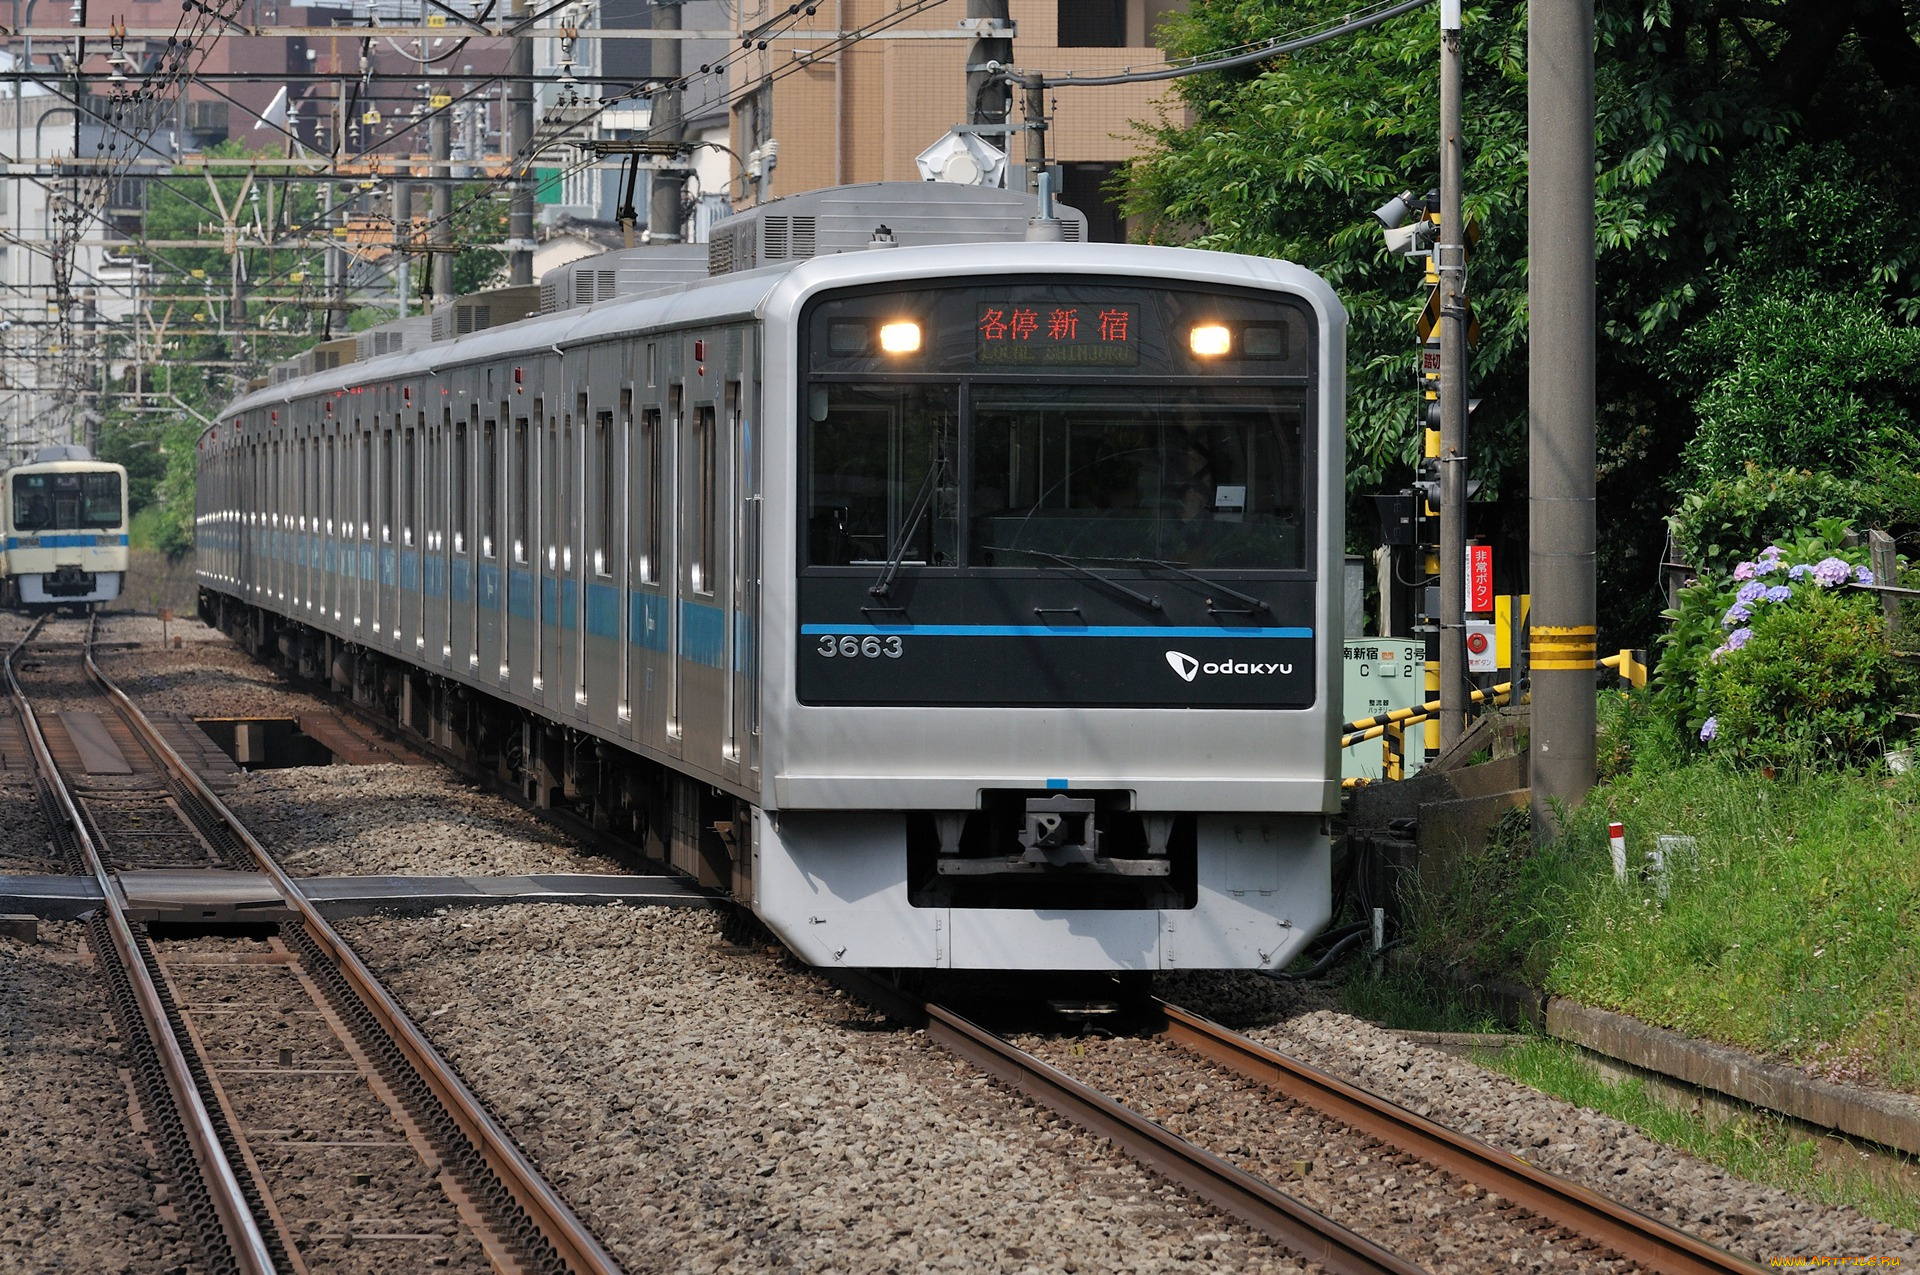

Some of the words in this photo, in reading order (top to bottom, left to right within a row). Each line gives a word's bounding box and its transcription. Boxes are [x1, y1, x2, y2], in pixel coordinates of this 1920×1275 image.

[980, 308, 1039, 341] 各停
[1475, 550, 1488, 608] 非常ボタン
[817, 634, 904, 659] 3663
[1344, 647, 1379, 660] 南新宿
[1203, 659, 1293, 674] odakyu
[1360, 664, 1370, 677] C
[1403, 664, 1413, 678] 2
